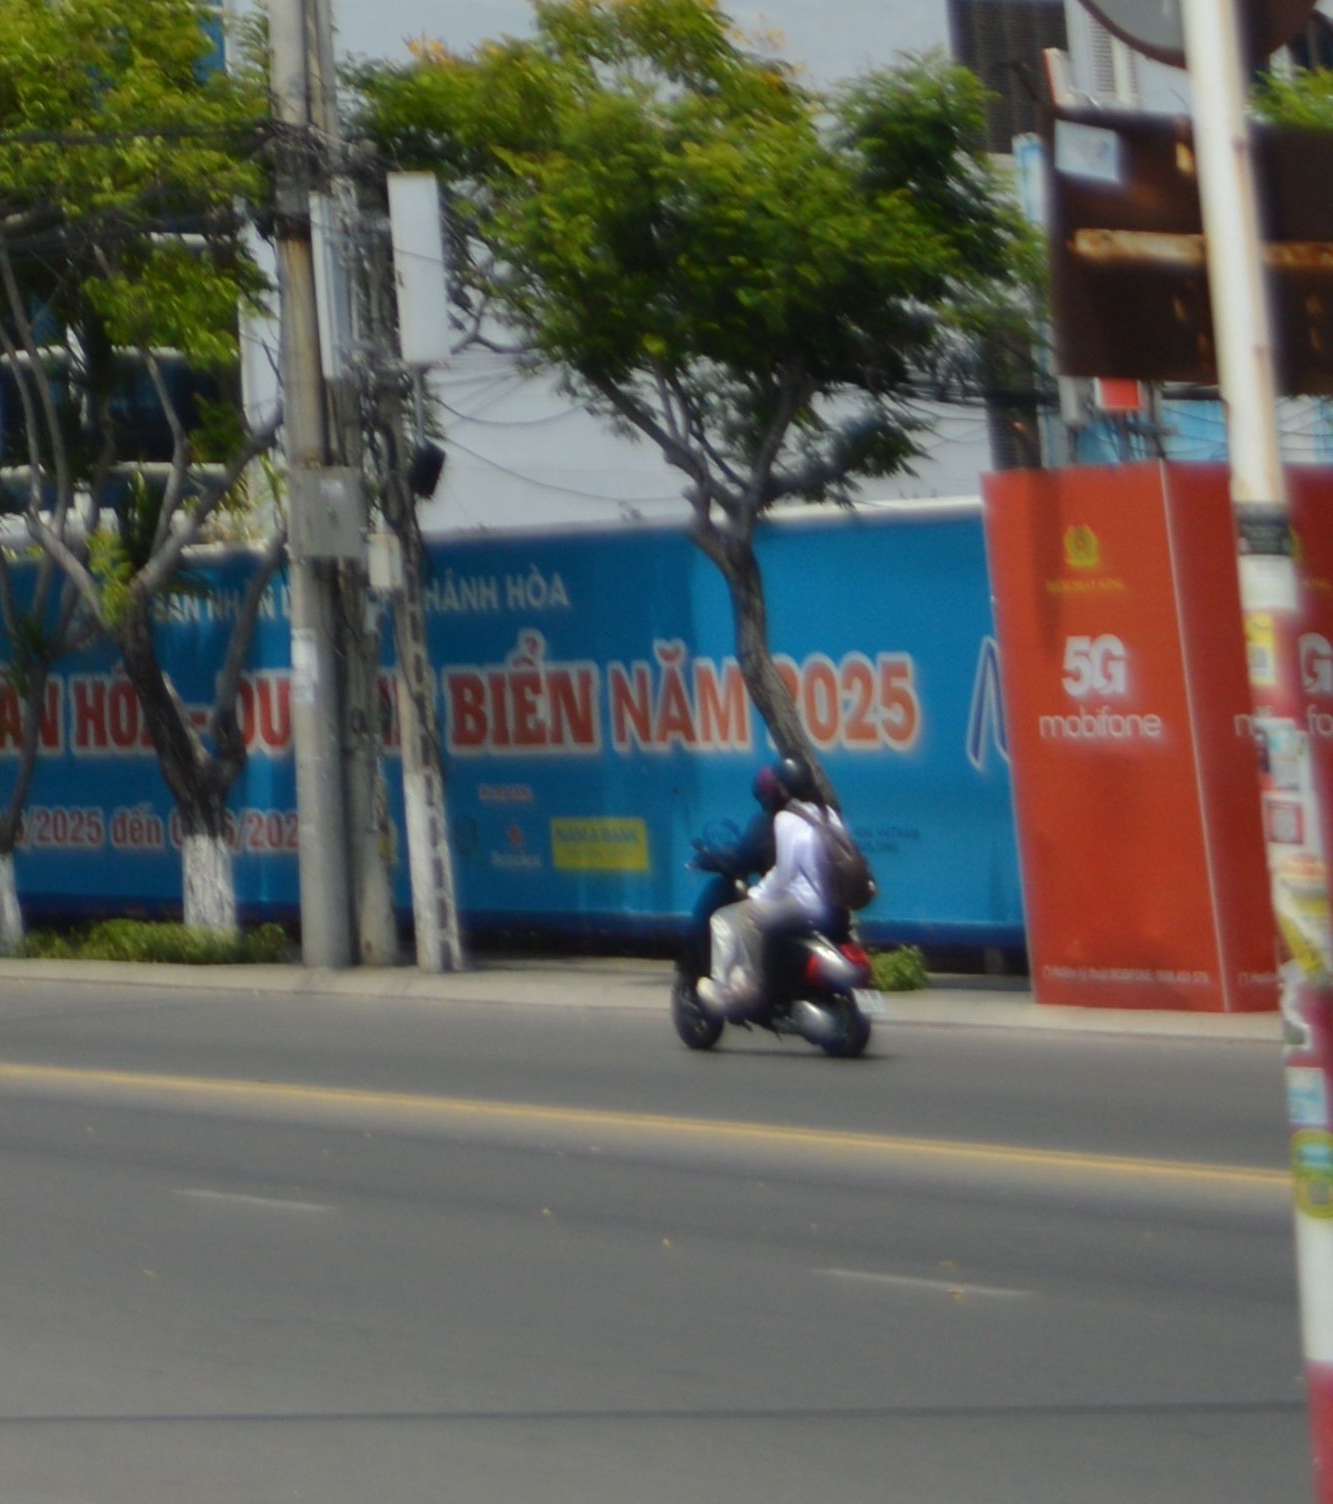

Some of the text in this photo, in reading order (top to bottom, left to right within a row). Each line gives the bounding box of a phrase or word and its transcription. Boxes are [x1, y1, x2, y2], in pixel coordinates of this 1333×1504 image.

[423, 569, 500, 612] HÁNH
[506, 564, 571, 610] HÒA
[1062, 633, 1127, 698] 5G
[1299, 633, 1333, 693] G
[71, 664, 156, 750] HÓ
[447, 636, 598, 747] BIỂN
[607, 644, 748, 745] NĂM
[1039, 705, 1162, 738] mobifone
[112, 802, 161, 842] đến
